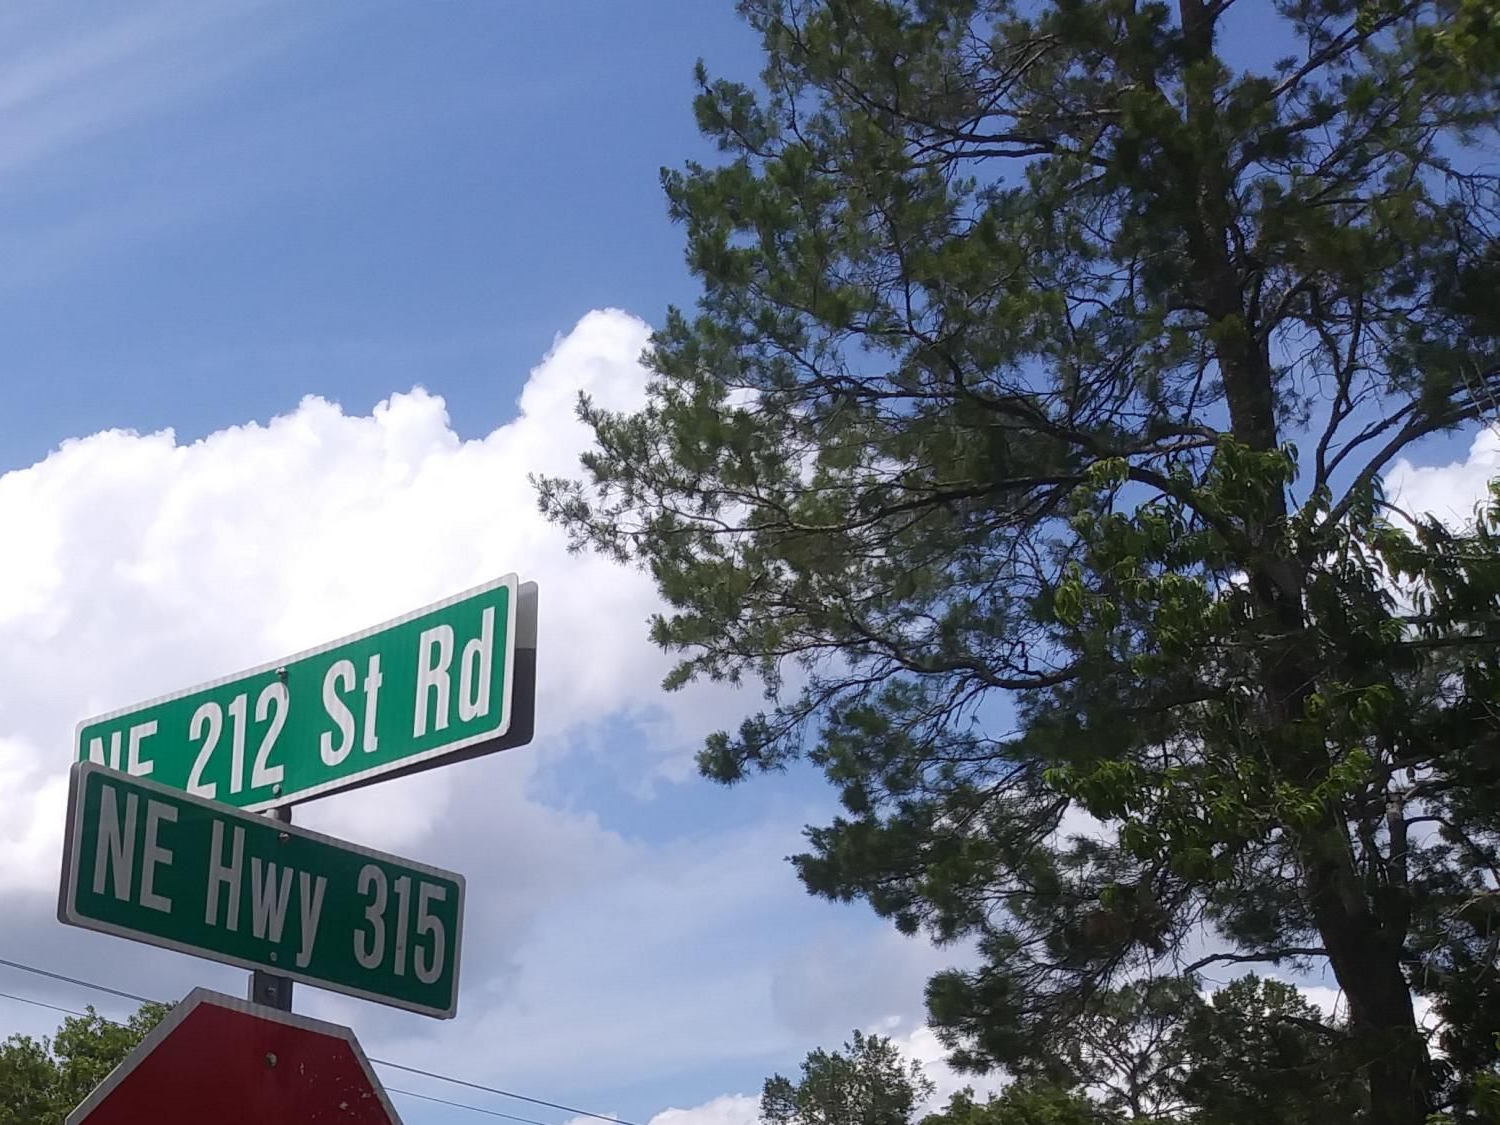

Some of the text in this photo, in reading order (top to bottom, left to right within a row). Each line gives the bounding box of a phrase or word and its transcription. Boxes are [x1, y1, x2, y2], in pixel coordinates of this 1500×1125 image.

[186, 682, 290, 800] 212
[320, 654, 383, 767] St
[413, 606, 495, 738] Rd
[92, 784, 447, 984] NE Hwy 315
